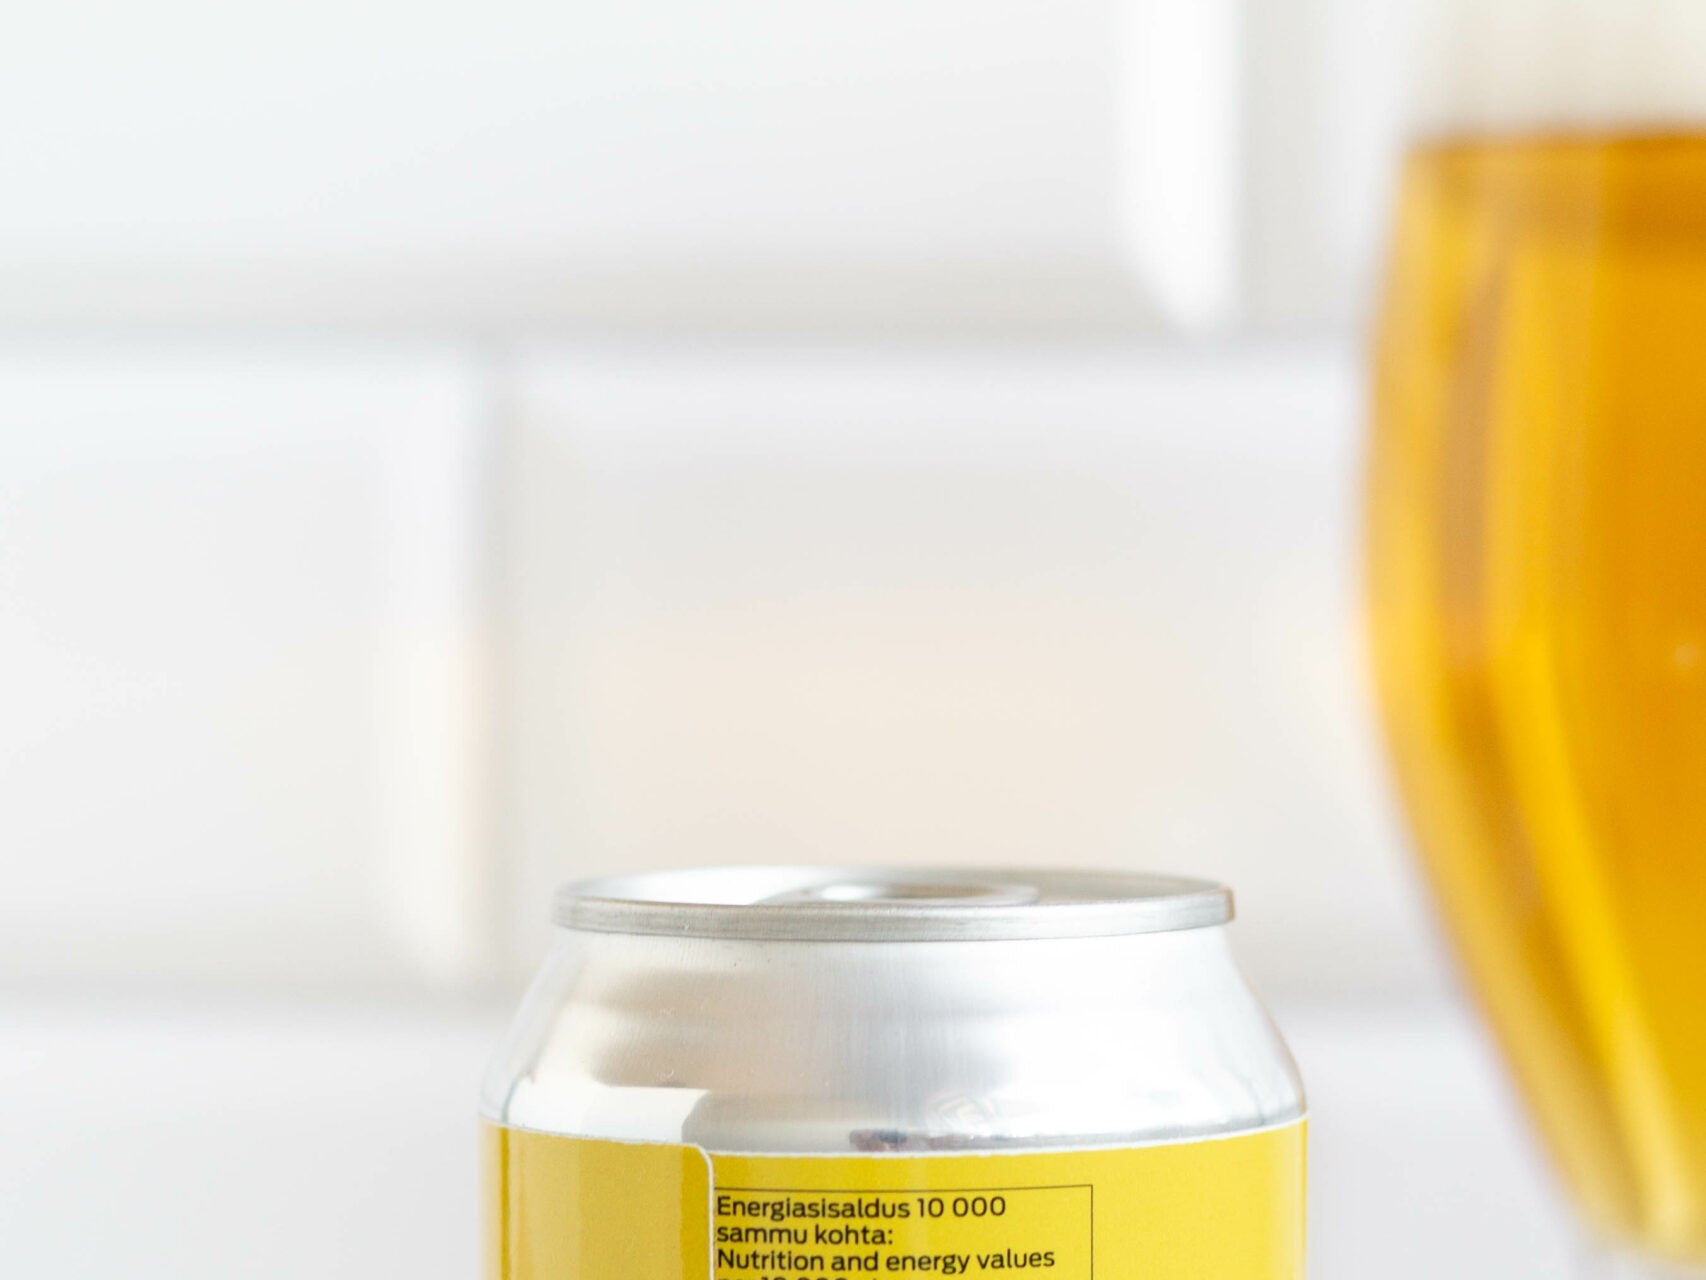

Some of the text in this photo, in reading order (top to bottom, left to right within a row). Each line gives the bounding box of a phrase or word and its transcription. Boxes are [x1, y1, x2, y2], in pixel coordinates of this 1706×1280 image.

[718, 1196, 1006, 1221] Energiasisaldus 10 000
[717, 1224, 892, 1245] sammu kohta:
[718, 1248, 1055, 1273] Nutrition and energy values
